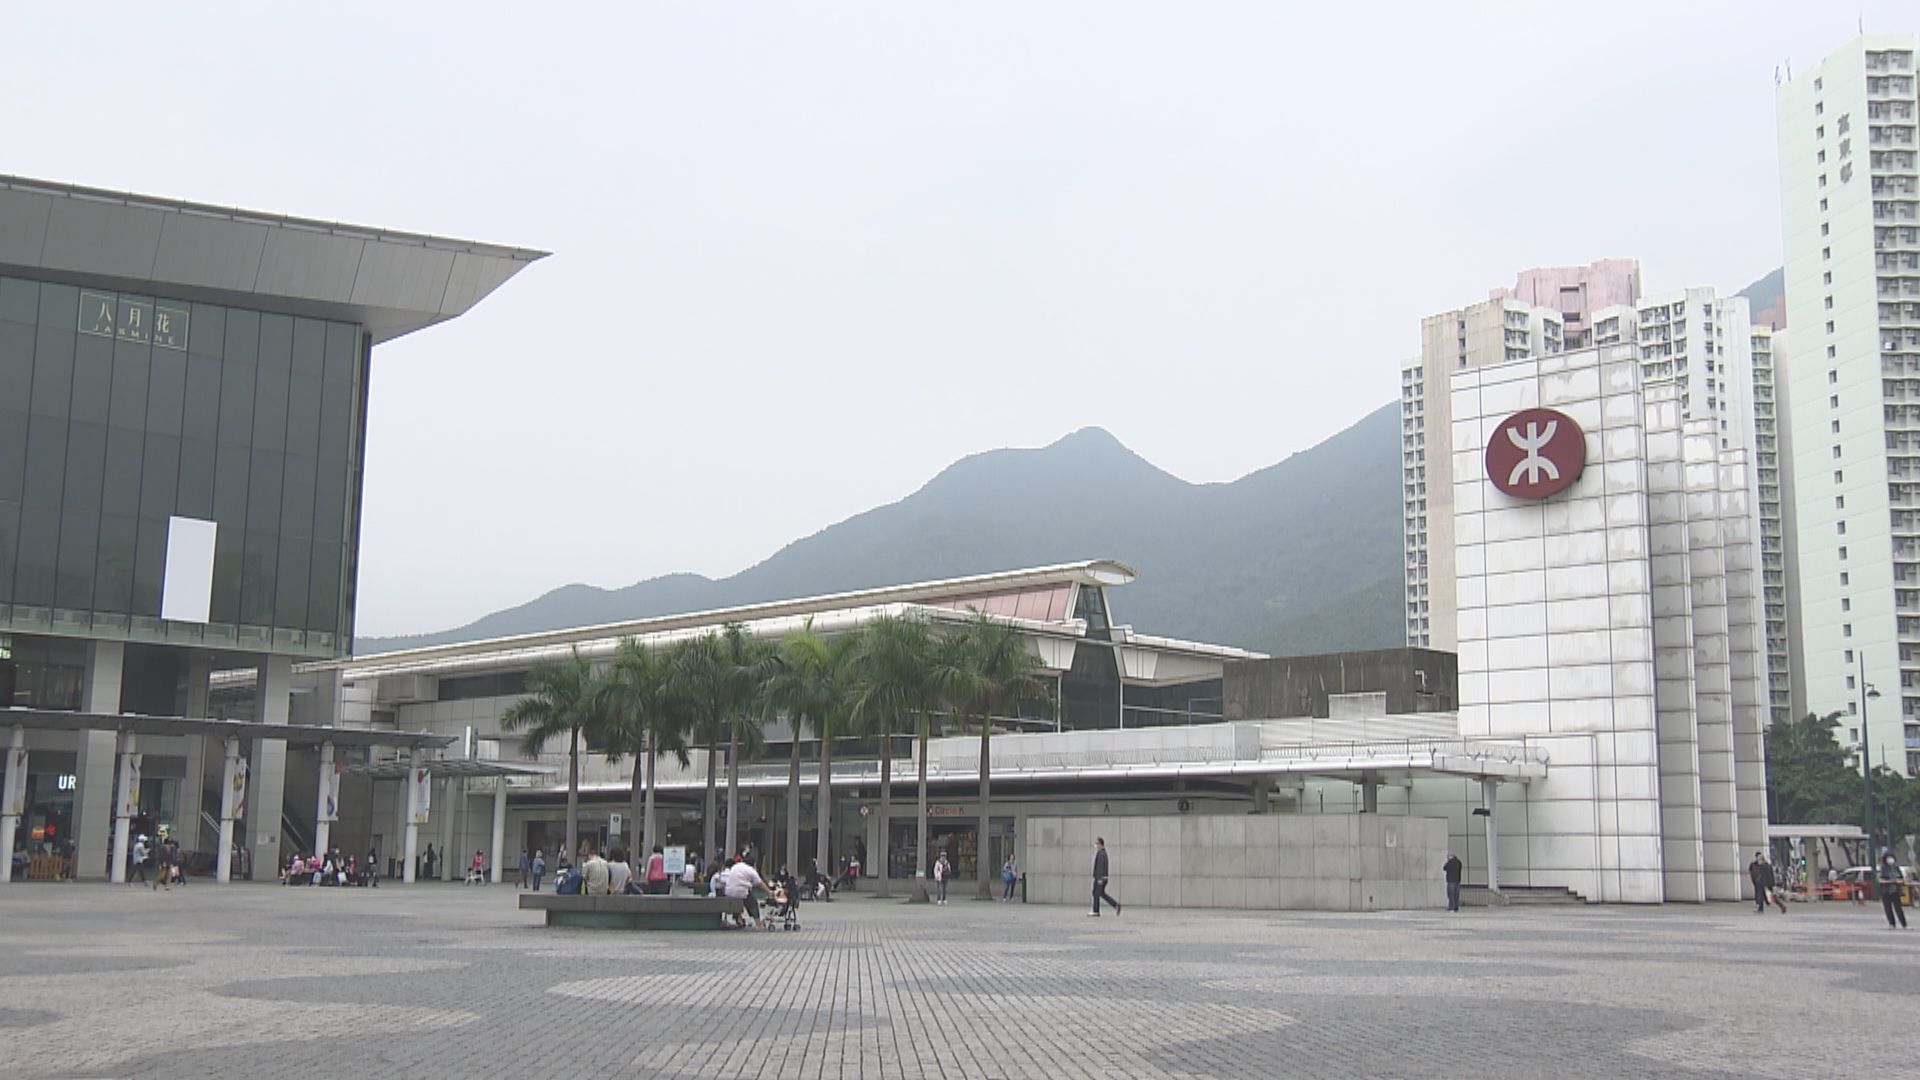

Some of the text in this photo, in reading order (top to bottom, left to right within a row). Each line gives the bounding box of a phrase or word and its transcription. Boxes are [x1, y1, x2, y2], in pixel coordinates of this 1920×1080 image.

[99, 302, 170, 333] 八月花
[93, 323, 174, 345] JASMINE
[58, 774, 77, 790] UR
